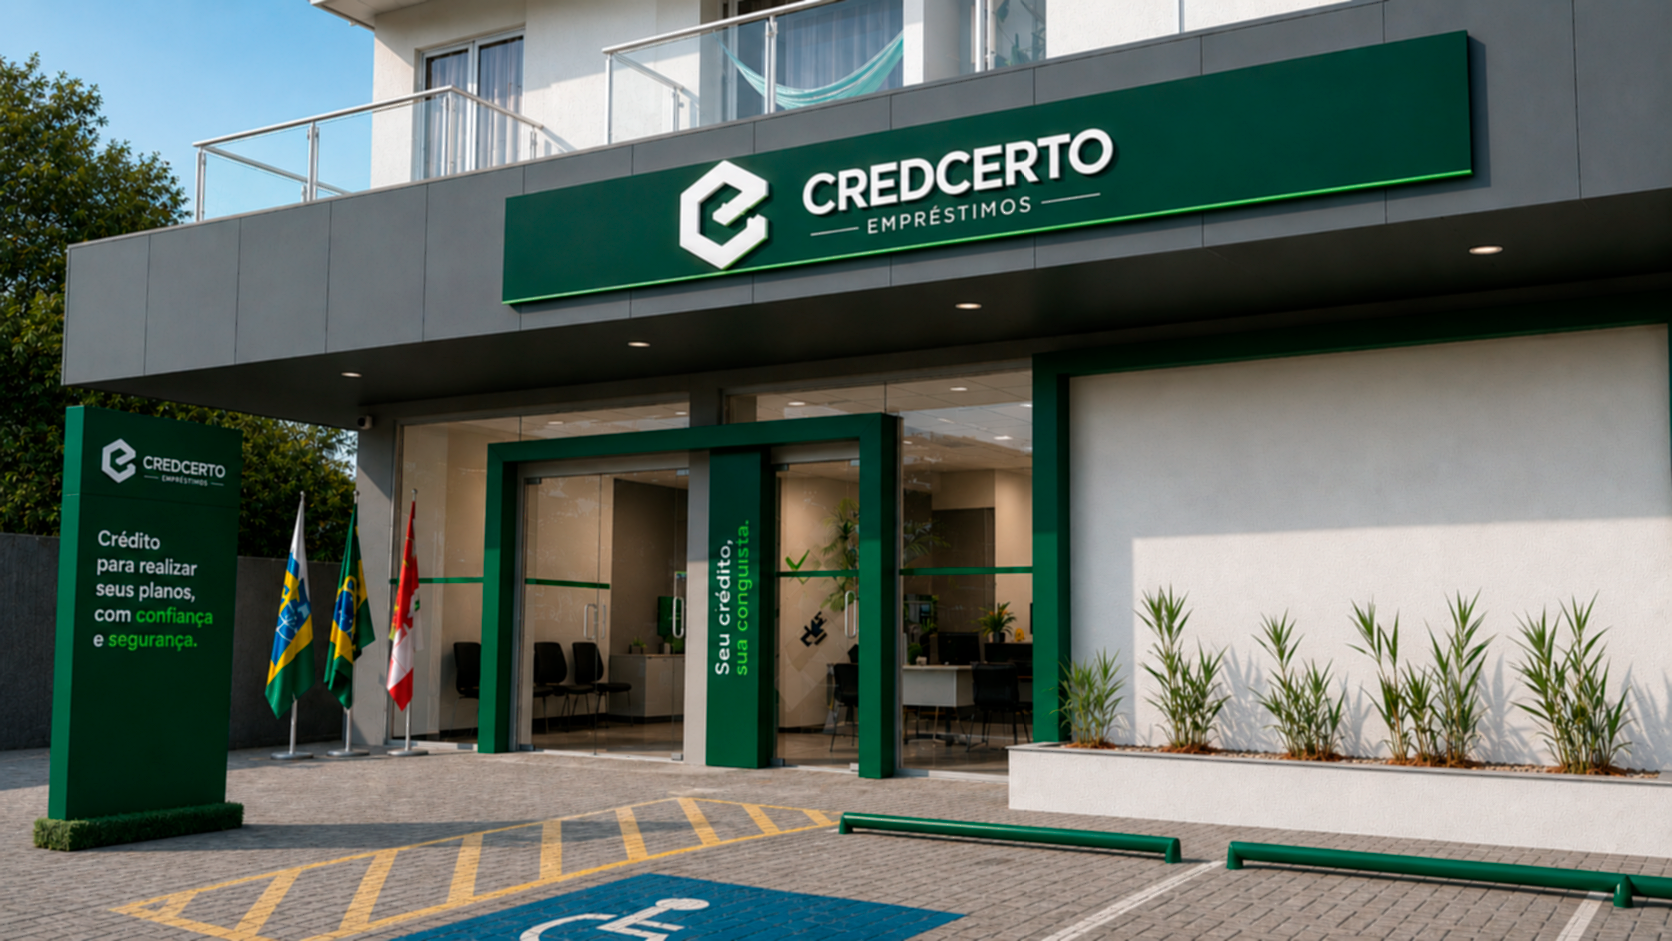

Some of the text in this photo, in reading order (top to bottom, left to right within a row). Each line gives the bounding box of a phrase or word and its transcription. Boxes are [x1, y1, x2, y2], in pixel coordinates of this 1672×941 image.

[802, 128, 1113, 215] CREDCERTO
[867, 196, 1031, 235] EMPRÉSTIMOS
[143, 455, 226, 479] CREDCERTO
[161, 474, 208, 487] EMPRÉSTIMOS
[97, 529, 161, 550] Crédito
[96, 558, 198, 576] para realizar
[96, 582, 195, 602] seus planos,
[94, 606, 213, 627] com confiança
[714, 539, 733, 675] Seu crédito,
[93, 634, 198, 651] e segurança.
[736, 639, 748, 676] sua
